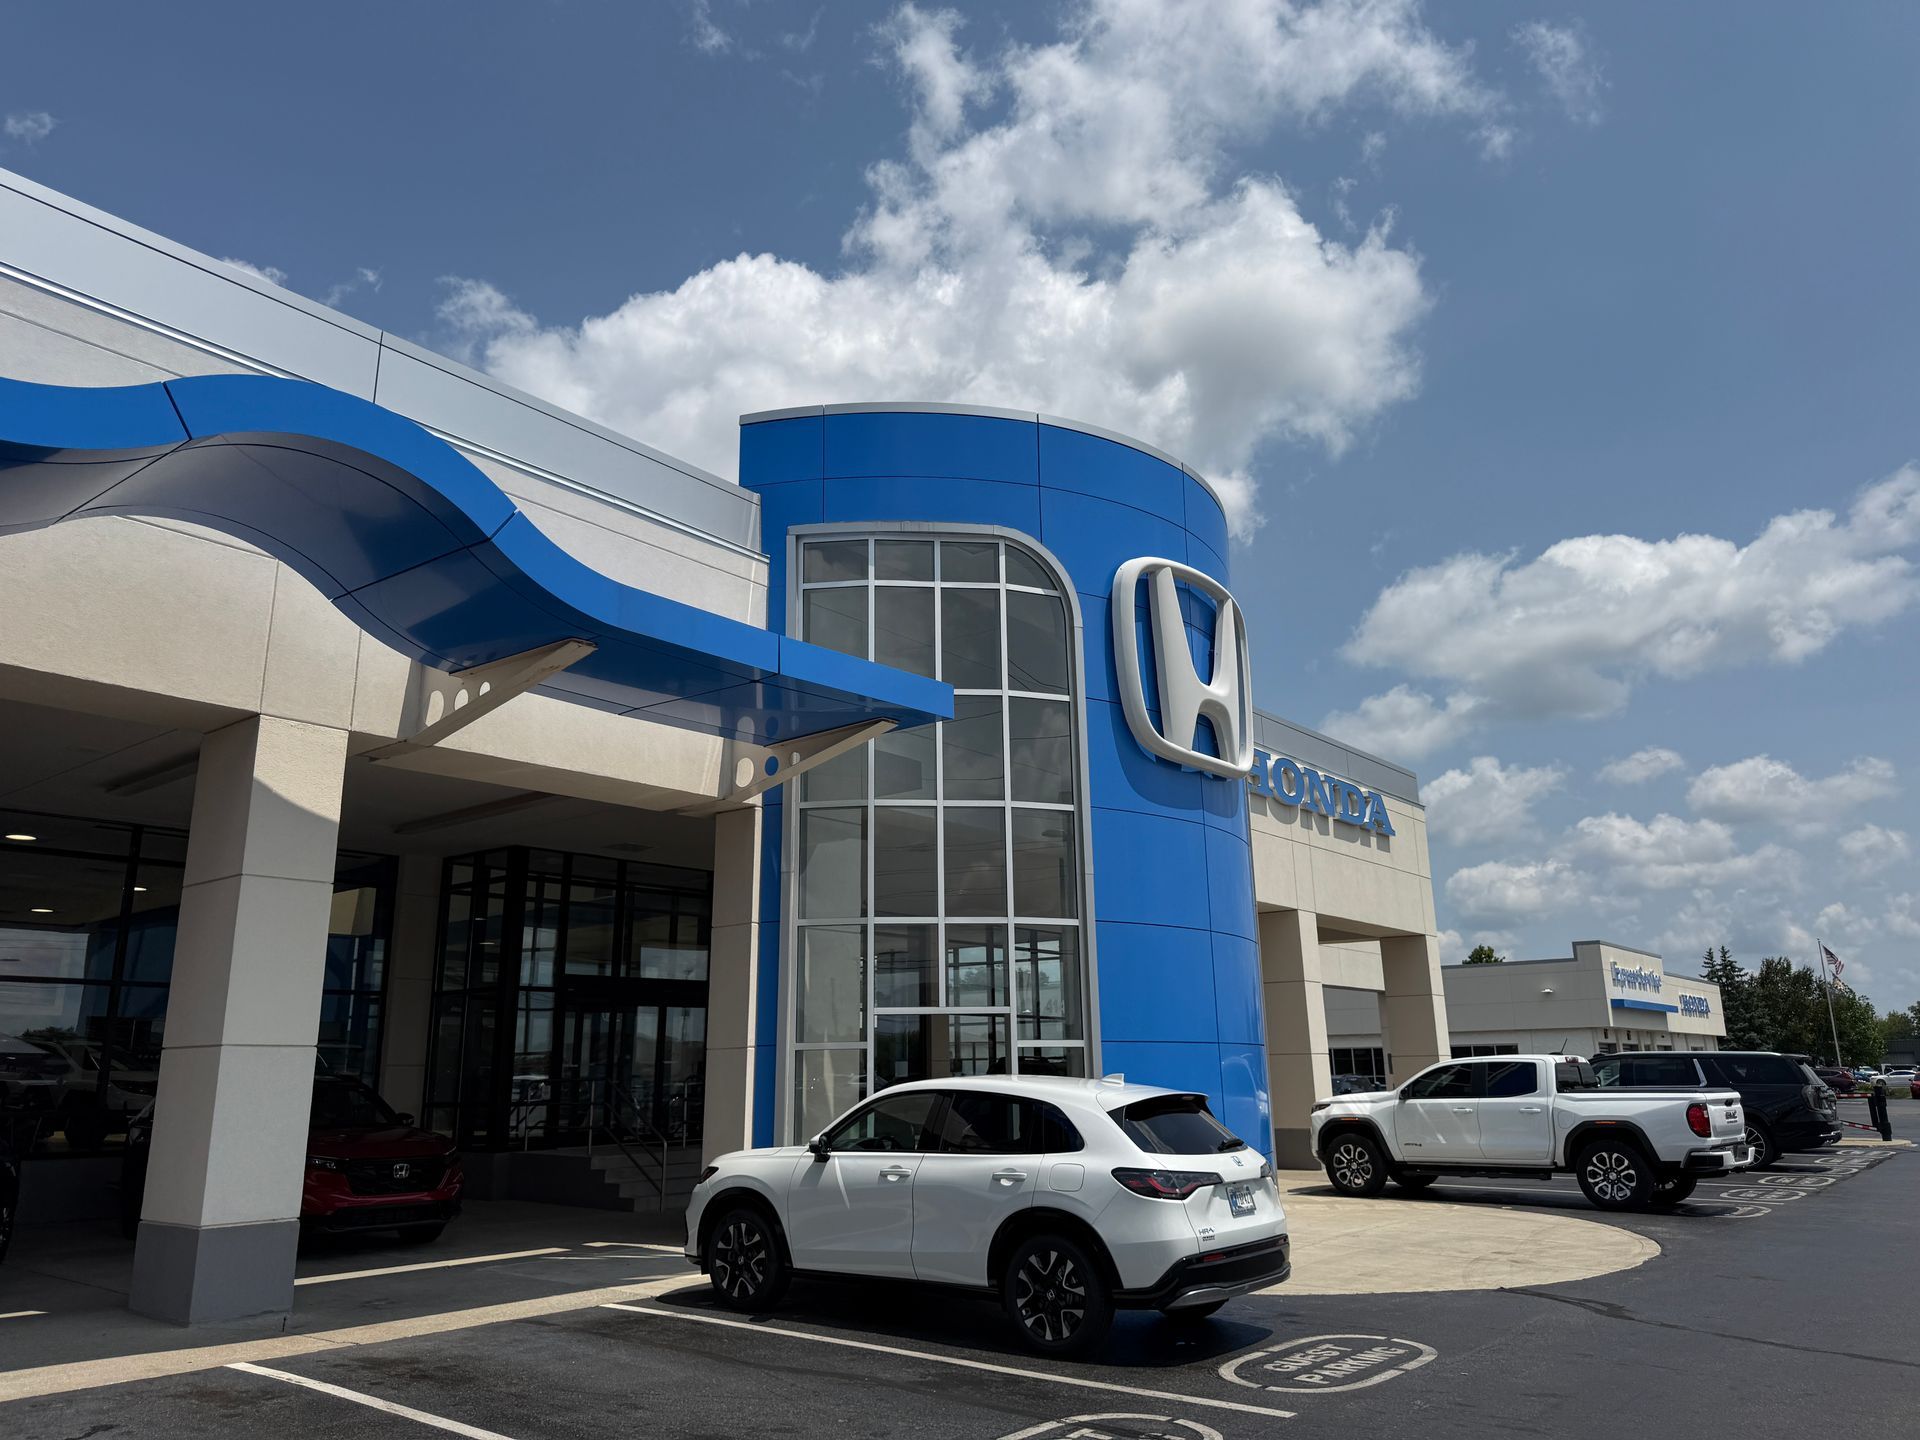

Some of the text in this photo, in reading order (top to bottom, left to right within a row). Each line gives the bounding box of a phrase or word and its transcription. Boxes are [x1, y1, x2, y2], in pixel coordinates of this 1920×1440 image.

[1248, 747, 1396, 837] HONDA
[1263, 1343, 1353, 1372] GUEST
[1293, 1346, 1409, 1384] PARKING
